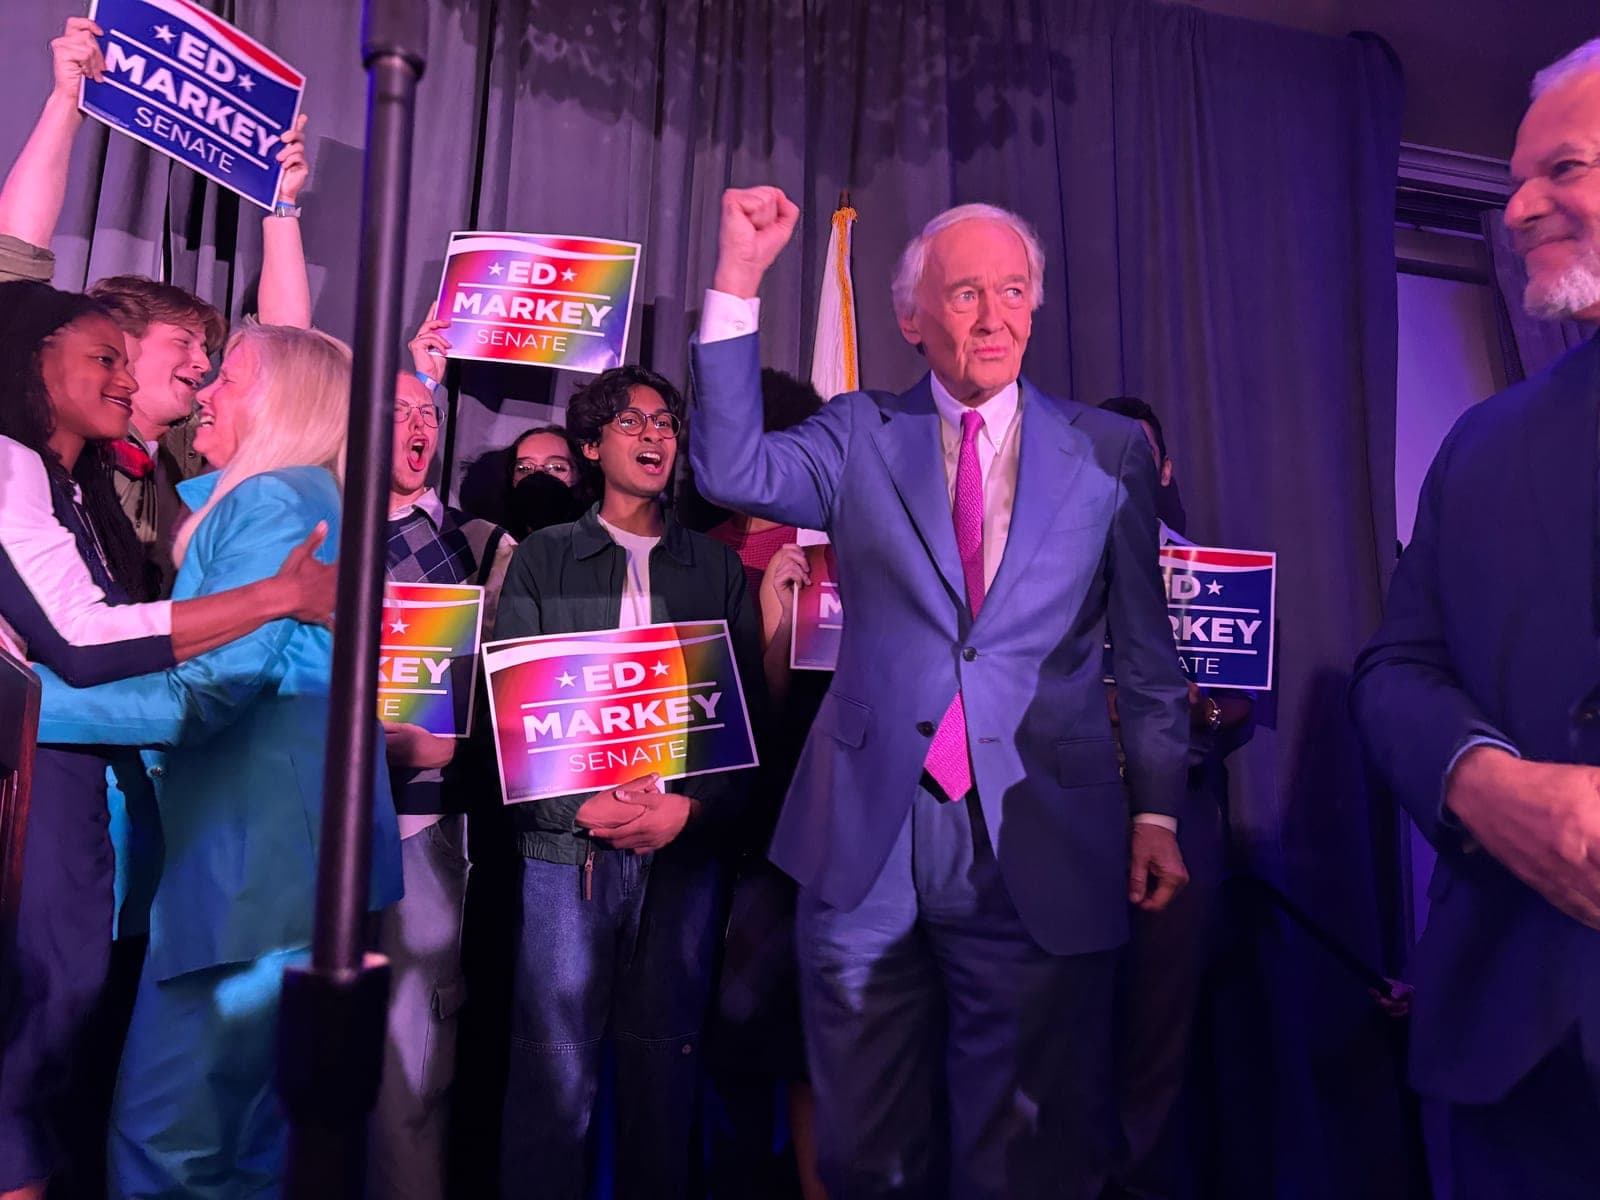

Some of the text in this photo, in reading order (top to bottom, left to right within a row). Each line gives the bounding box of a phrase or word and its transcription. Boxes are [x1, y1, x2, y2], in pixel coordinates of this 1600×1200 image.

[178, 31, 237, 83] ED
[105, 41, 280, 157] MARKEY
[134, 107, 235, 174] SENATE
[507, 260, 557, 285] ED
[452, 291, 612, 327] MARKEY
[477, 328, 568, 352] SENATE
[1162, 574, 1201, 600] D
[583, 661, 646, 692] ED
[522, 692, 722, 743] MARKEY
[569, 739, 687, 773] SENATE
